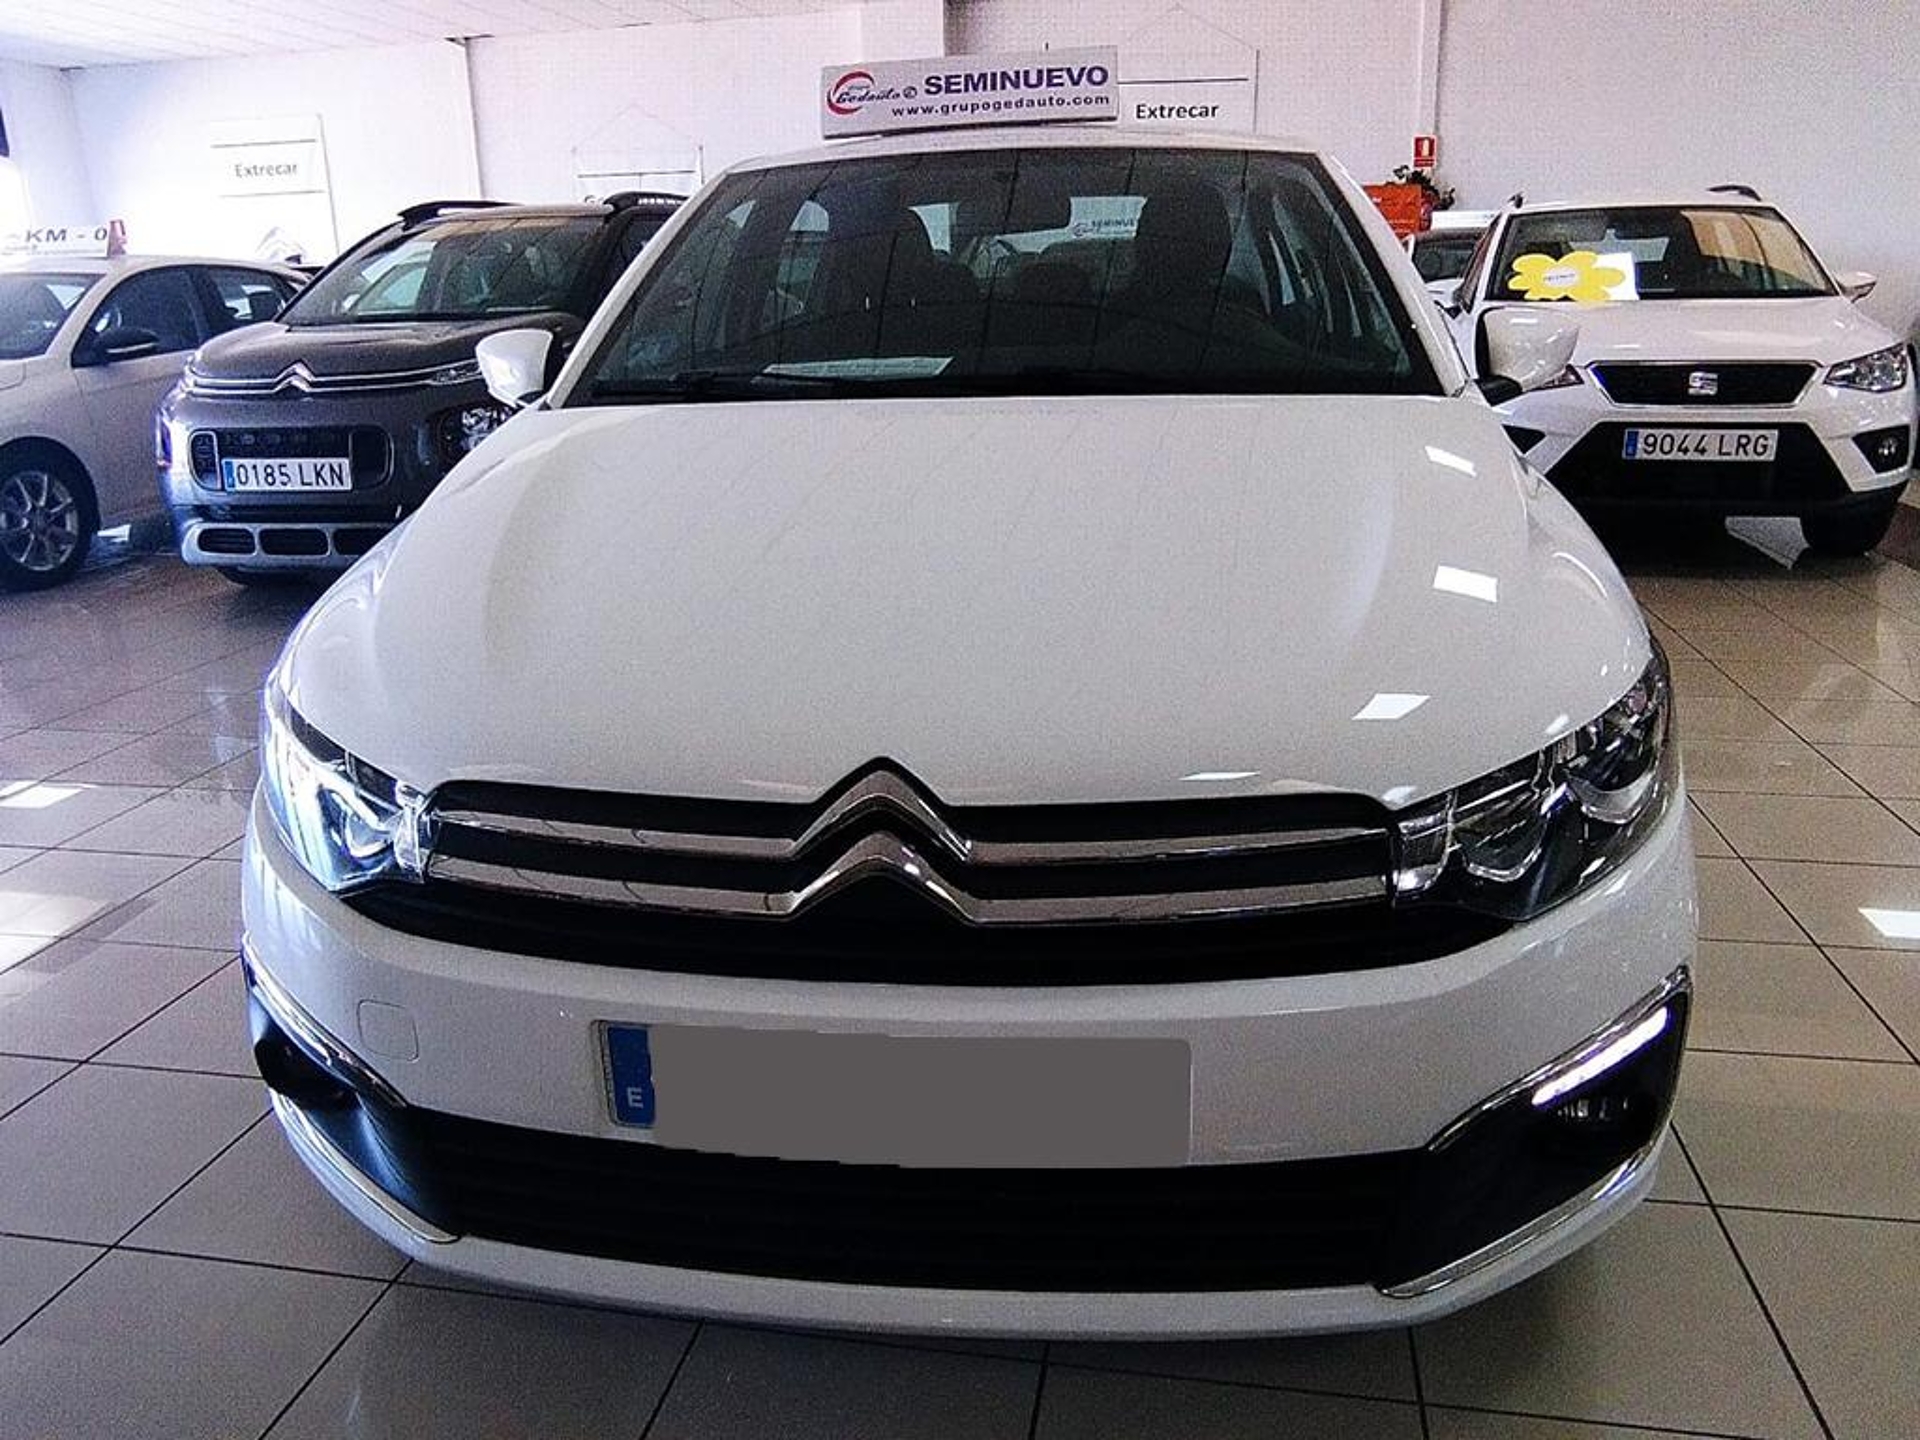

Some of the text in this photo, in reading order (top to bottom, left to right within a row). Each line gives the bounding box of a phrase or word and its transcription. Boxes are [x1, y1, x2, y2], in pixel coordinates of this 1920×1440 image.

[924, 66, 1109, 96] SEMINUEVO
[892, 95, 1110, 117] www.grupogedauto.com
[1135, 101, 1219, 120] Extrecar
[234, 163, 298, 178] Extrecar
[26, 229, 67, 242] KM
[1642, 433, 1708, 456] 9044
[1718, 434, 1769, 457] LRG
[236, 463, 344, 486] 0185 LKN
[626, 1086, 644, 1109] E
